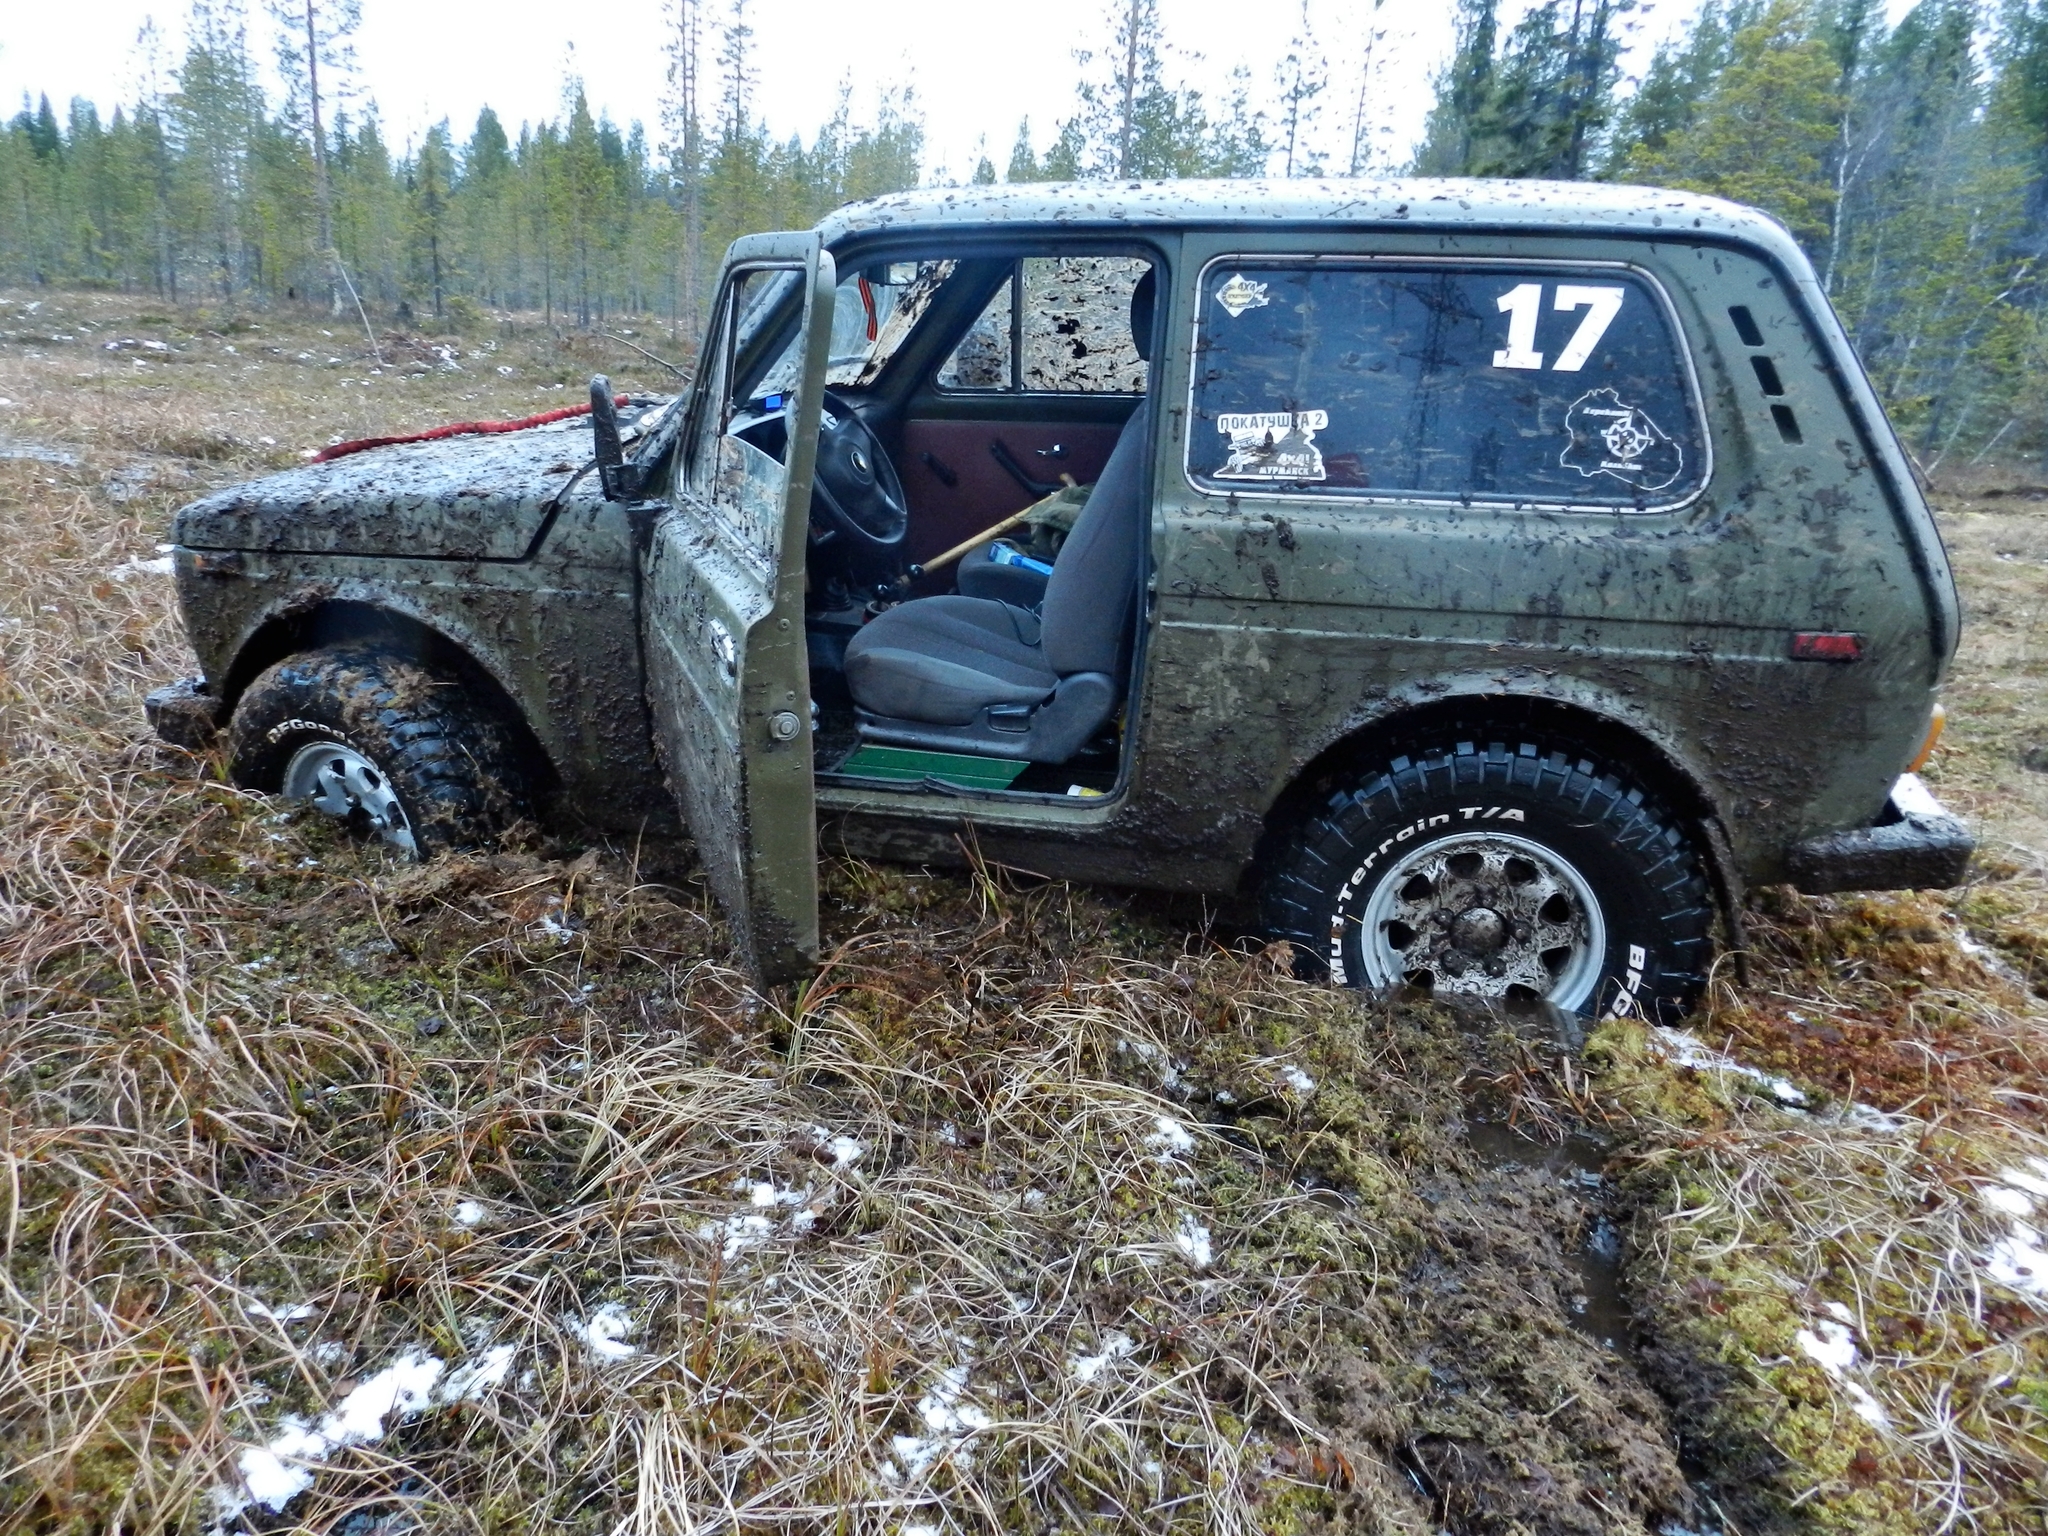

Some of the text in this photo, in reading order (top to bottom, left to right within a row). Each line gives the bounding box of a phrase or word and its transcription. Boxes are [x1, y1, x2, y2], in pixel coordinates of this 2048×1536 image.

[1492, 283, 1625, 371] 17
[1220, 412, 1323, 430] ПОКАТУША 2
[1459, 806, 1525, 823] T/A
